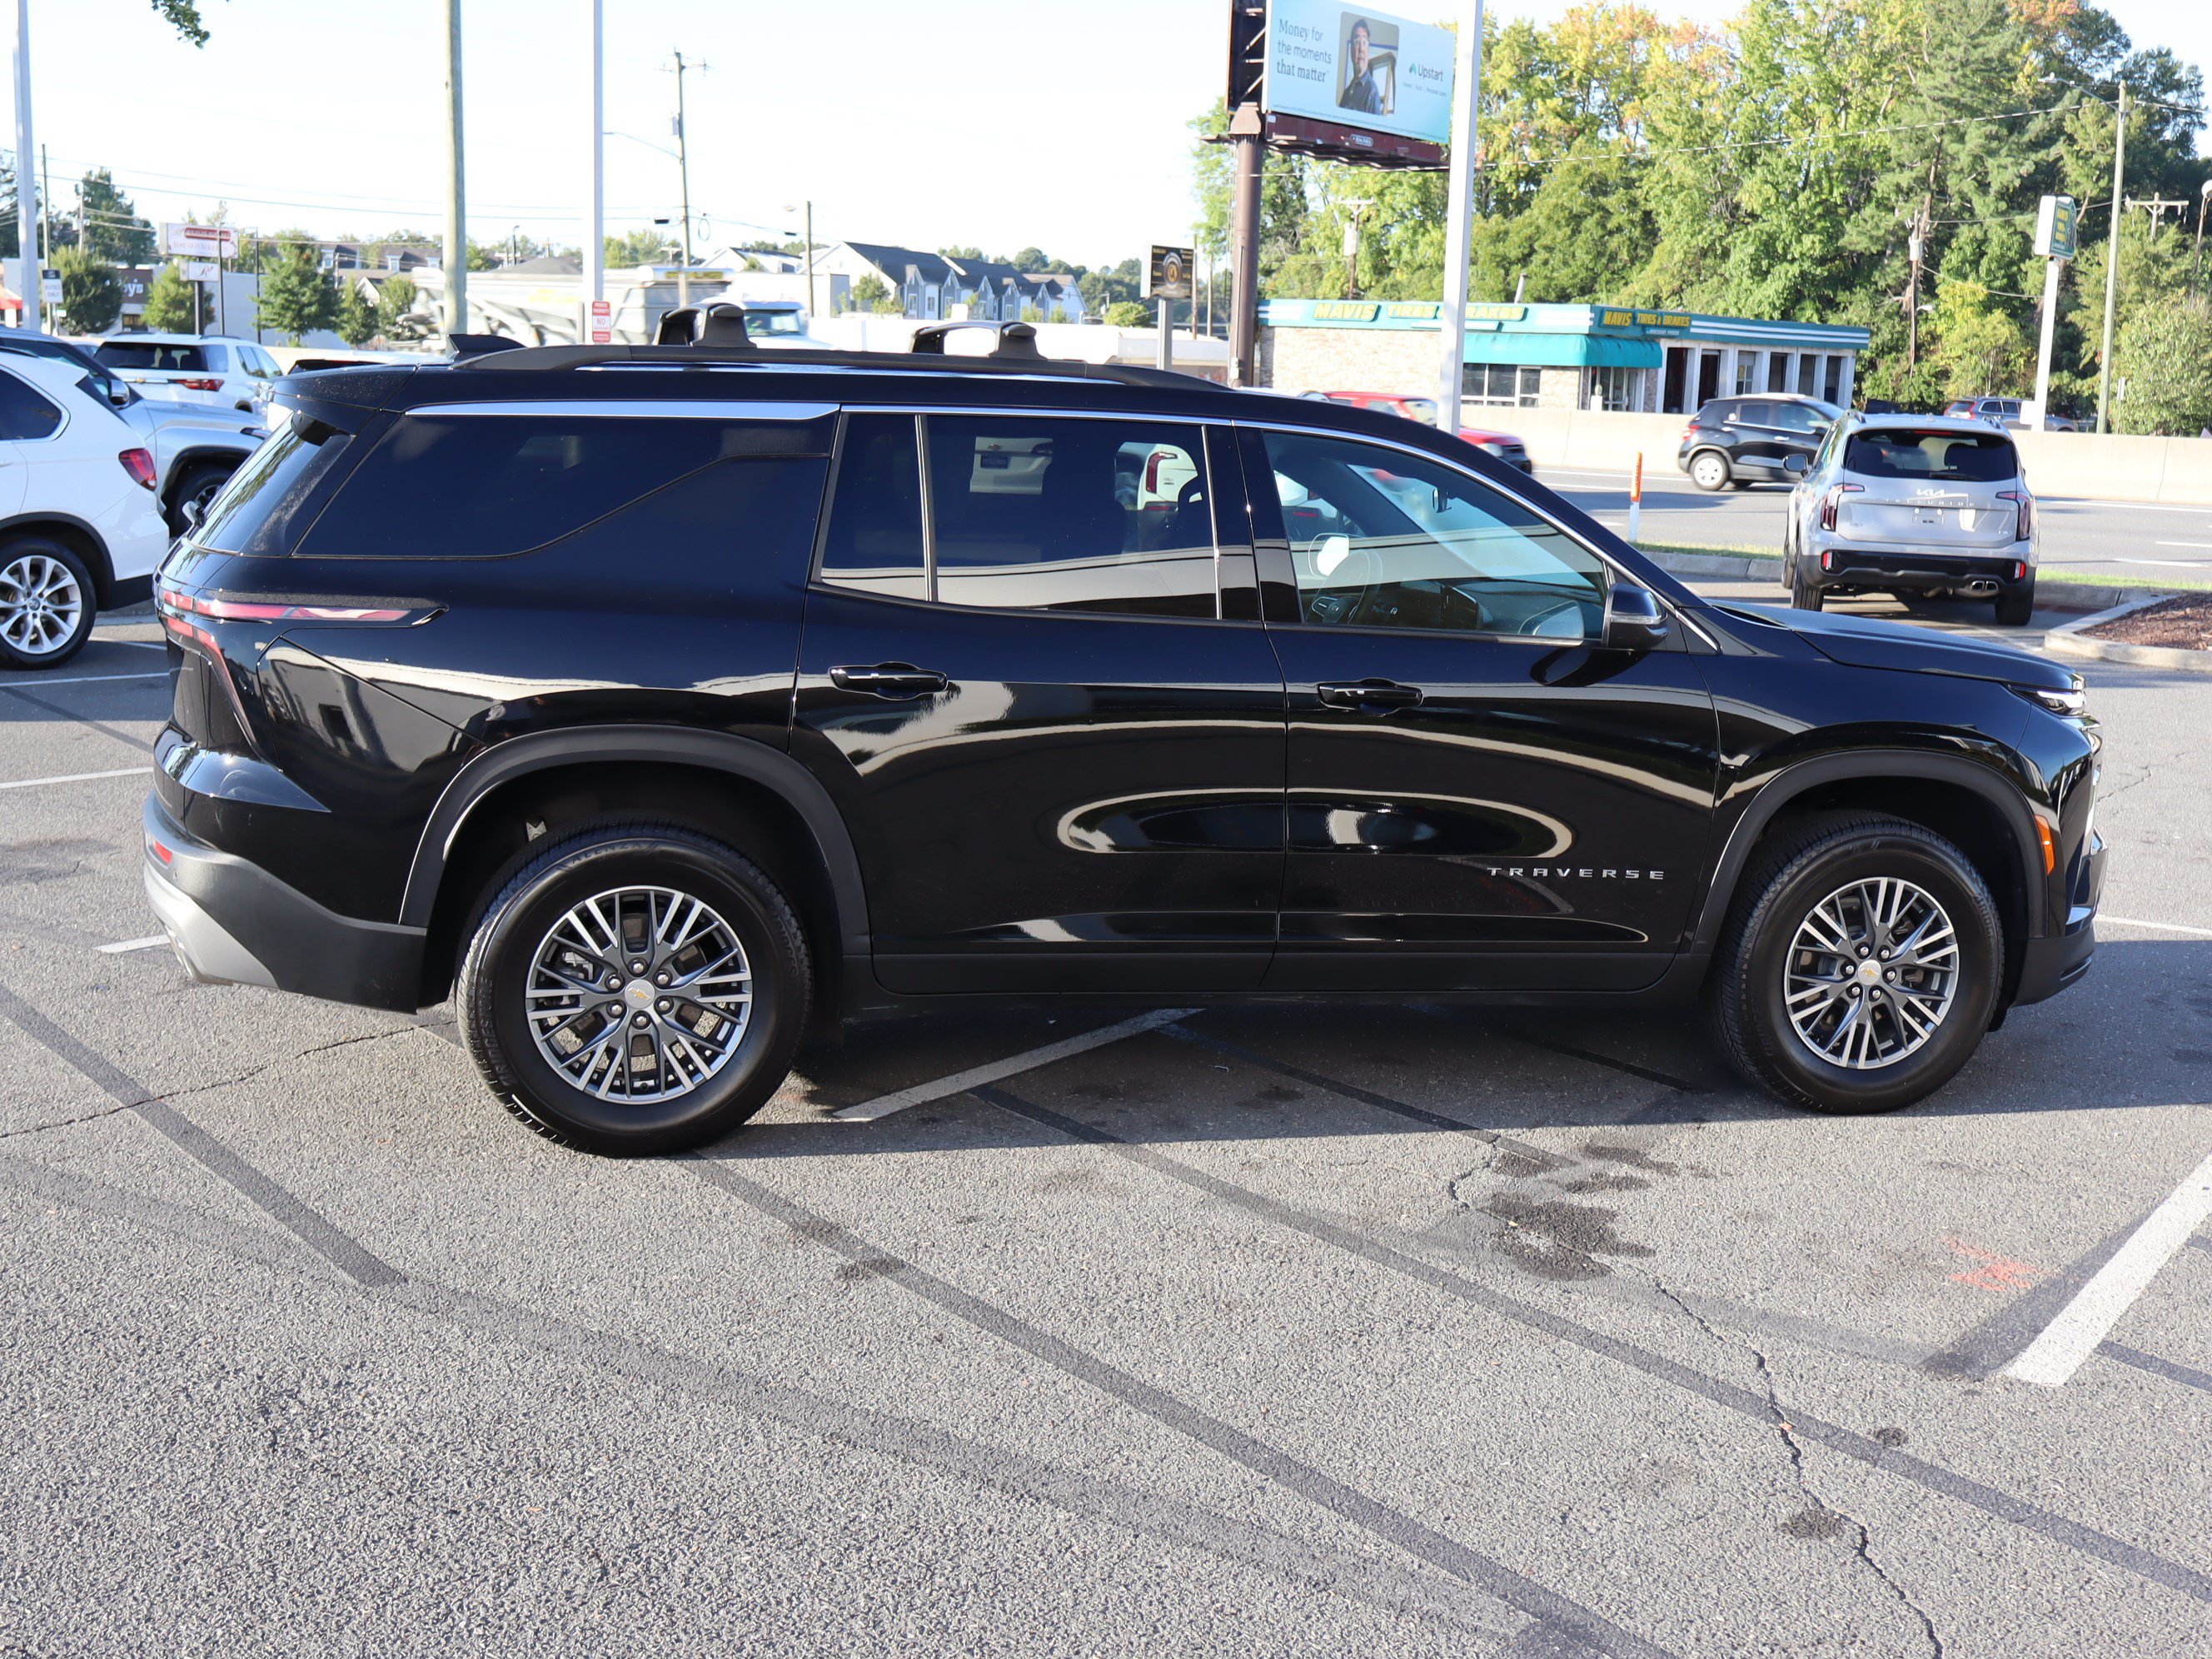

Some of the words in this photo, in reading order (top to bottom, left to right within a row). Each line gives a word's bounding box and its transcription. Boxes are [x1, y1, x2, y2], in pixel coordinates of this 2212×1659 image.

[1278, 18, 1309, 42] Money
[1312, 26, 1323, 42] for
[1278, 40, 1292, 55] the
[1293, 46, 1333, 64] moments
[1277, 58, 1295, 77] that
[1417, 63, 1443, 82] Upstart
[1313, 303, 1377, 320] MAVIS
[1387, 305, 1435, 318] TIRES
[1466, 306, 1523, 321] RAKES
[1602, 311, 1632, 326] MAVIS
[1637, 312, 1657, 325] TIRES
[1663, 315, 1691, 327] BRAKES
[1916, 488, 1945, 498] KIA
[1886, 498, 1975, 507] TELLURIDE
[1487, 867, 1664, 879] TRAVERSE
